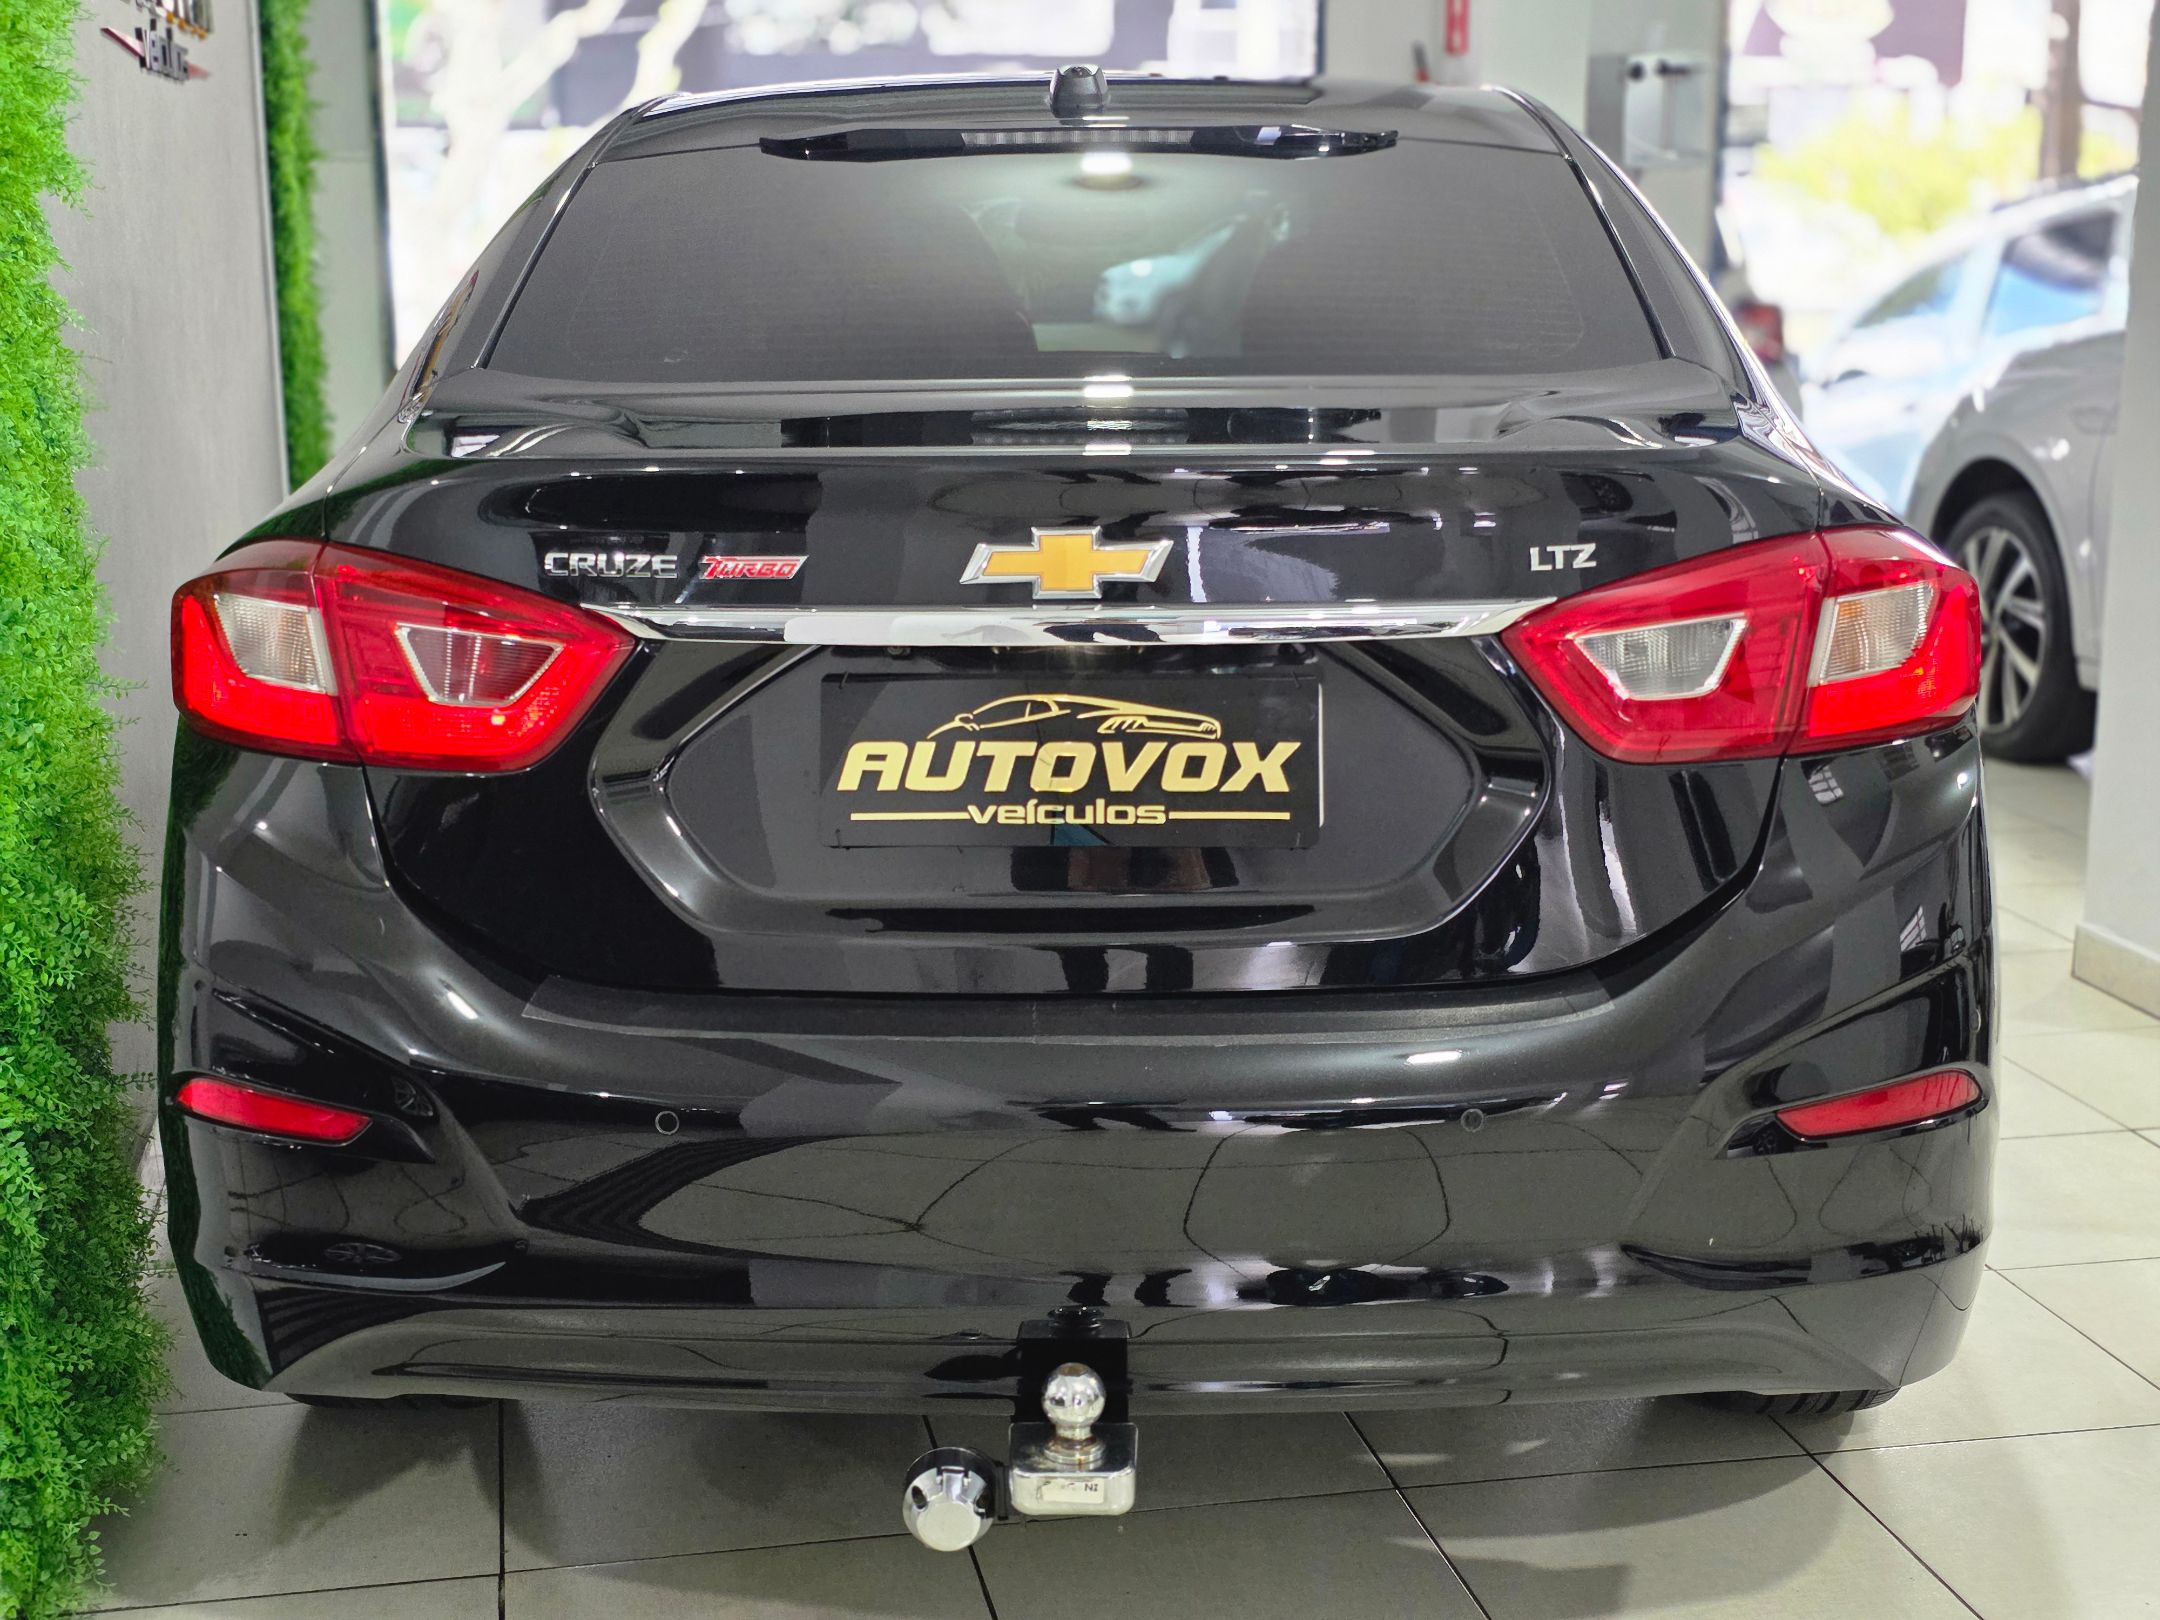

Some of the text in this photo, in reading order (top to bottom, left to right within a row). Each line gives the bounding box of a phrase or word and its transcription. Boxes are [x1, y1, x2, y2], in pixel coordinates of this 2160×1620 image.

[544, 553, 799, 579] CRUZE TURBO
[1529, 543, 1597, 571] LTZ
[836, 741, 1301, 793] AUTOVOX
[967, 798, 1167, 825] veículos
